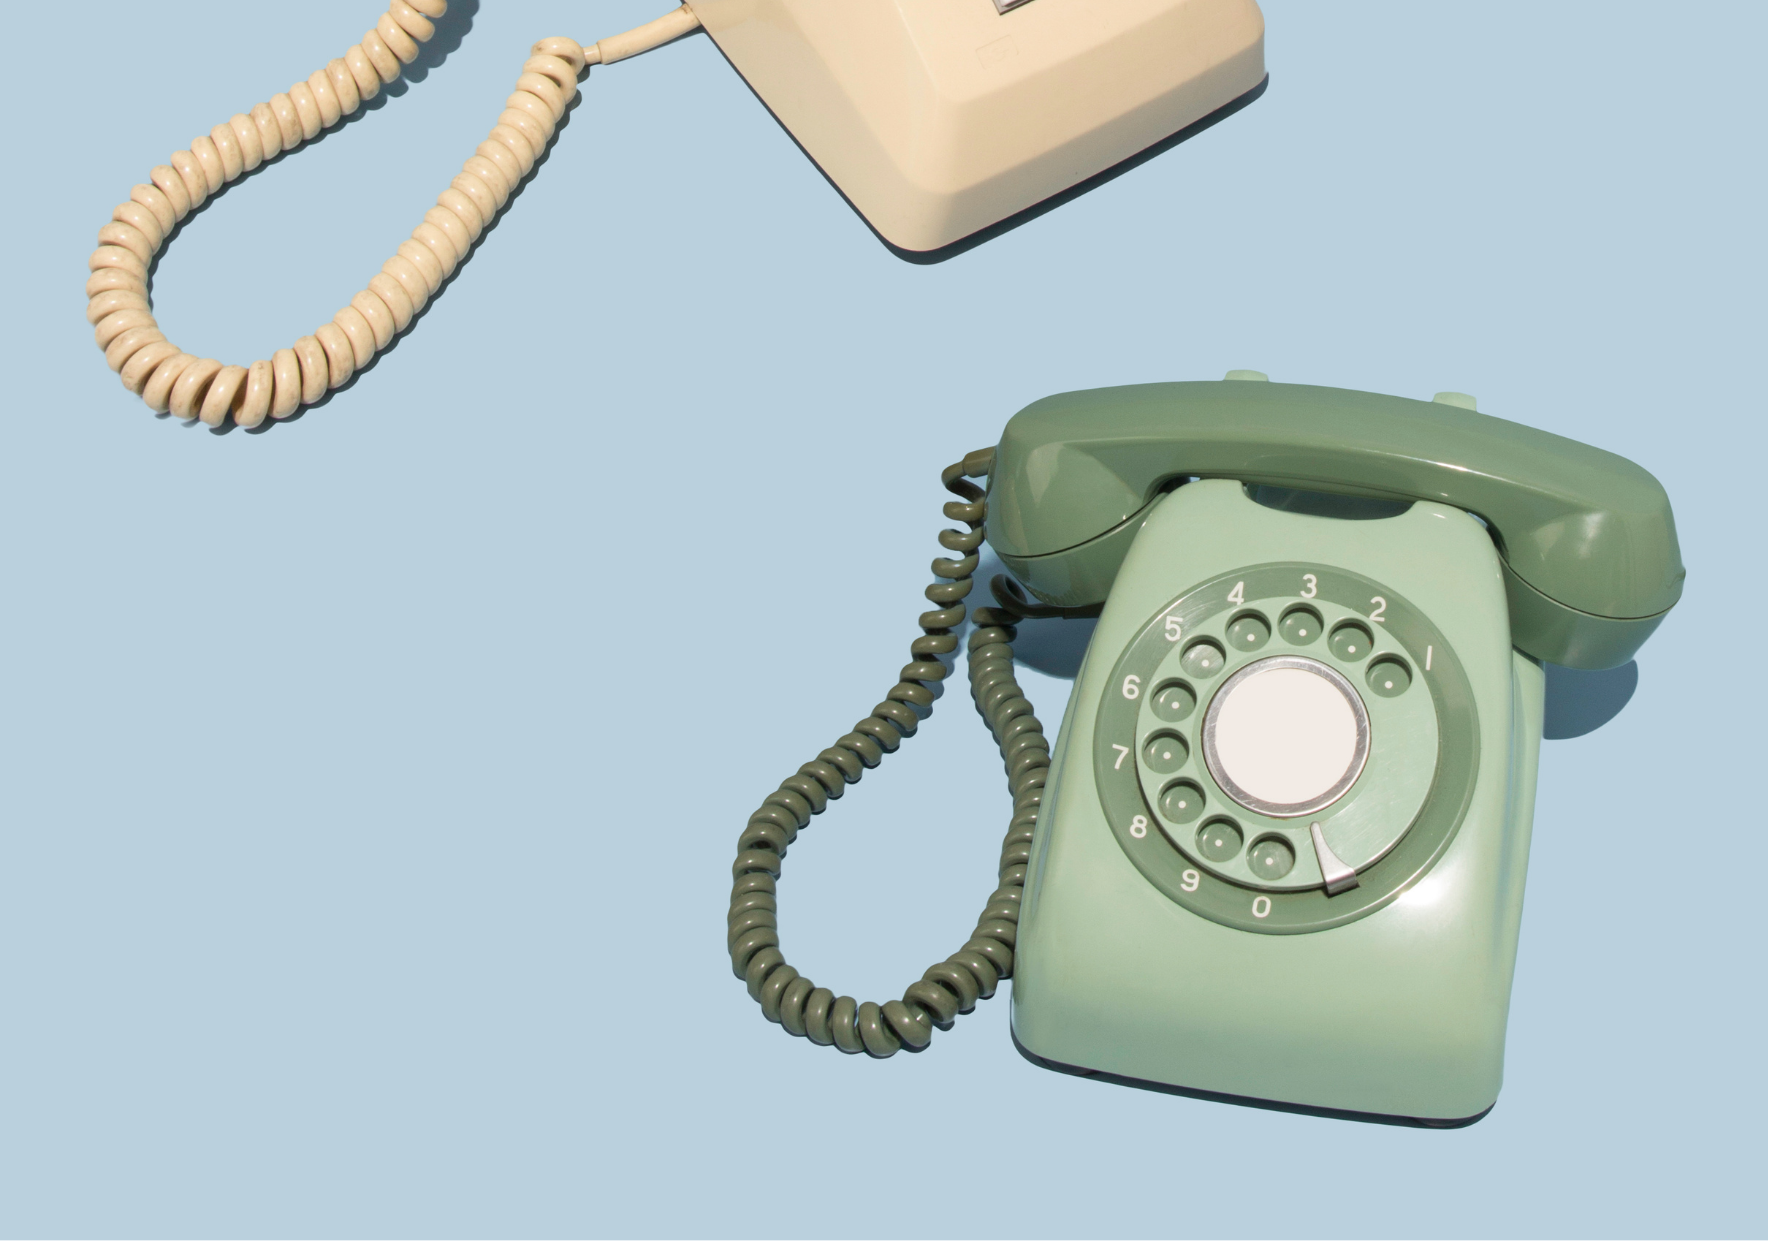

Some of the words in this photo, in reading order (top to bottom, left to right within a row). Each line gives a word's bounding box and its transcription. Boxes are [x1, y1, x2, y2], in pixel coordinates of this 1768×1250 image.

[1226, 581, 1246, 608] 4
[1298, 573, 1319, 600] 3
[1368, 596, 1387, 623] 2
[1164, 615, 1184, 642] 5
[1122, 674, 1141, 700] 6
[1111, 743, 1129, 770] 7
[1129, 814, 1148, 839] 8
[1180, 868, 1200, 892] 9
[1251, 895, 1272, 919] 0
